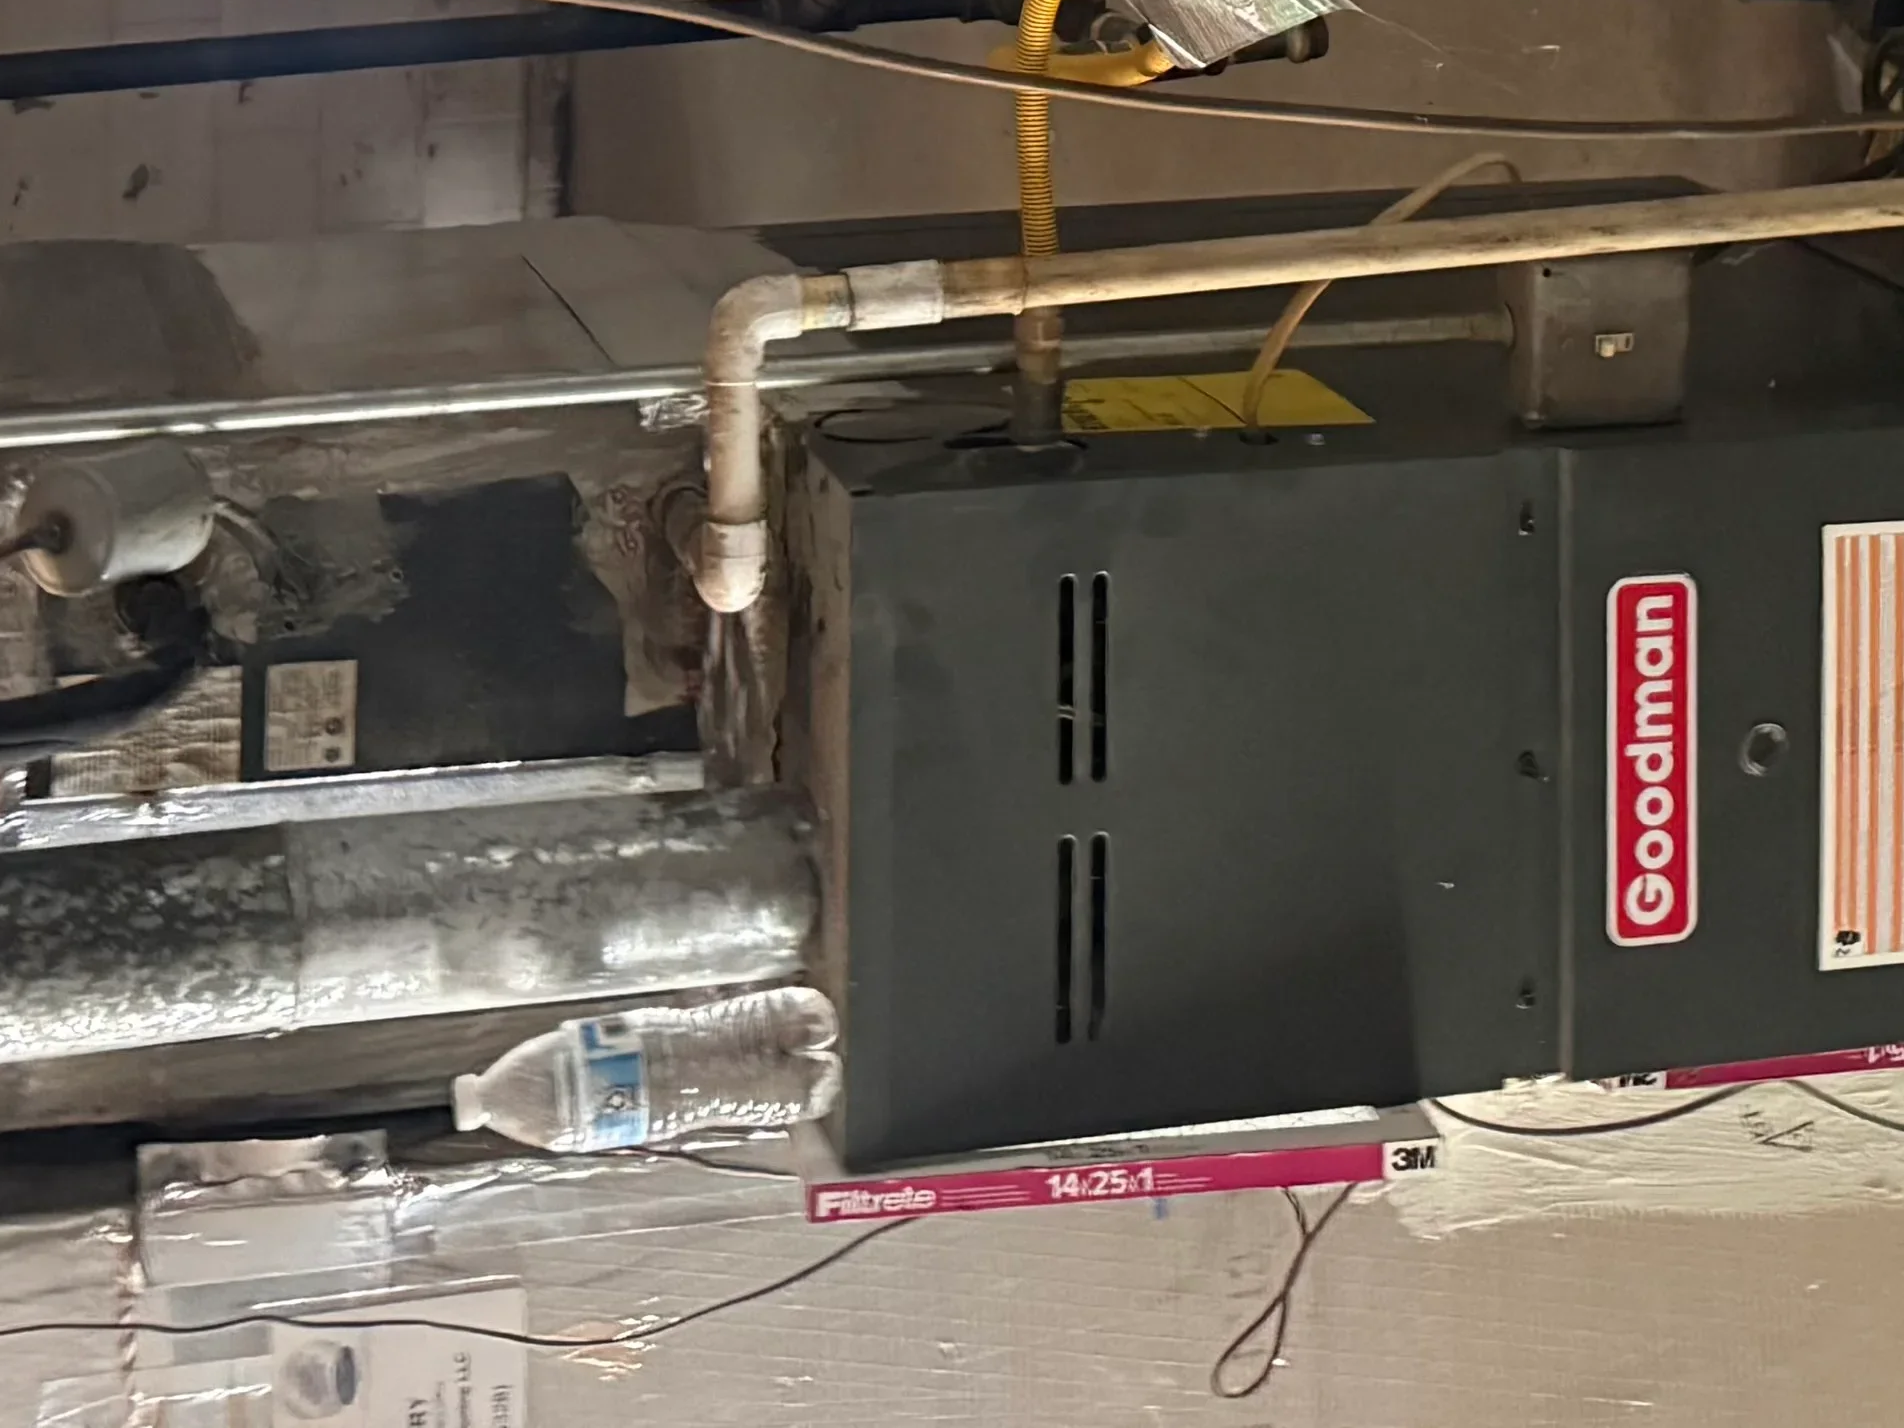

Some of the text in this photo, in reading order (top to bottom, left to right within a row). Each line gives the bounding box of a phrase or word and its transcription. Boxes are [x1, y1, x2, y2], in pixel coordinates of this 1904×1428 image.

[1623, 594, 1676, 927] Goodman
[1391, 1147, 1436, 1172] 3M
[816, 1186, 936, 1217] Filtrete
